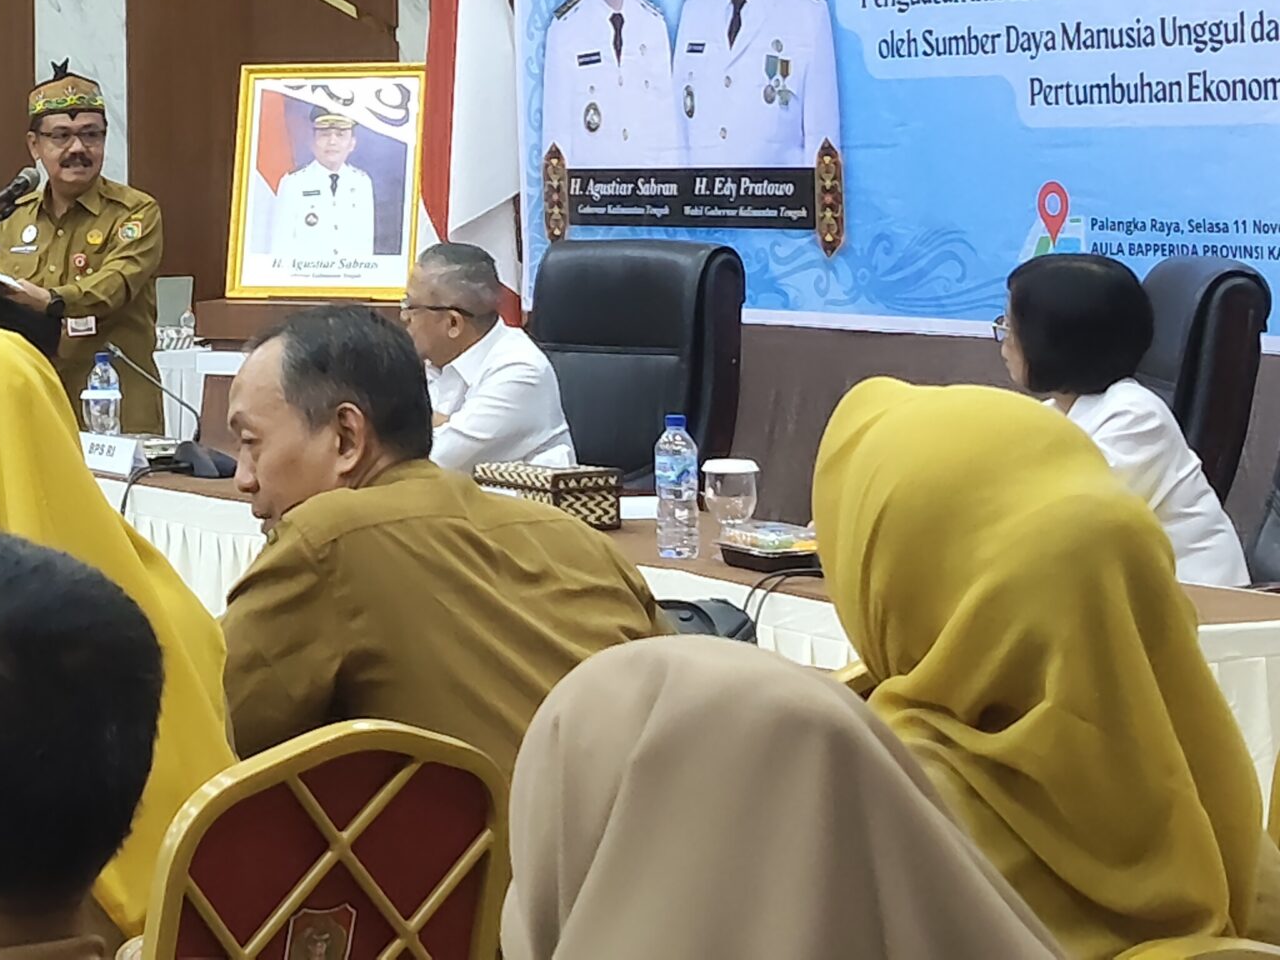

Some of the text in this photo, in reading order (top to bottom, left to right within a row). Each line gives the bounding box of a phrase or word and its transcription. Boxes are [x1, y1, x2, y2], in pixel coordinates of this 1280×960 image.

[878, 10, 1280, 60] oleh Sumber Daya Manusia Unggul da
[1029, 71, 1183, 106] Pertumbuhan
[570, 177, 678, 201] H. Agustiar Sabran
[694, 177, 794, 201] H. Edy Pratowo
[1090, 217, 1280, 237] Palangka Raya, Selasa 11 Nov
[1091, 242, 1125, 257] AULA
[1128, 242, 1199, 257] BAPPERIDA
[1203, 244, 1263, 260] PROVINSI
